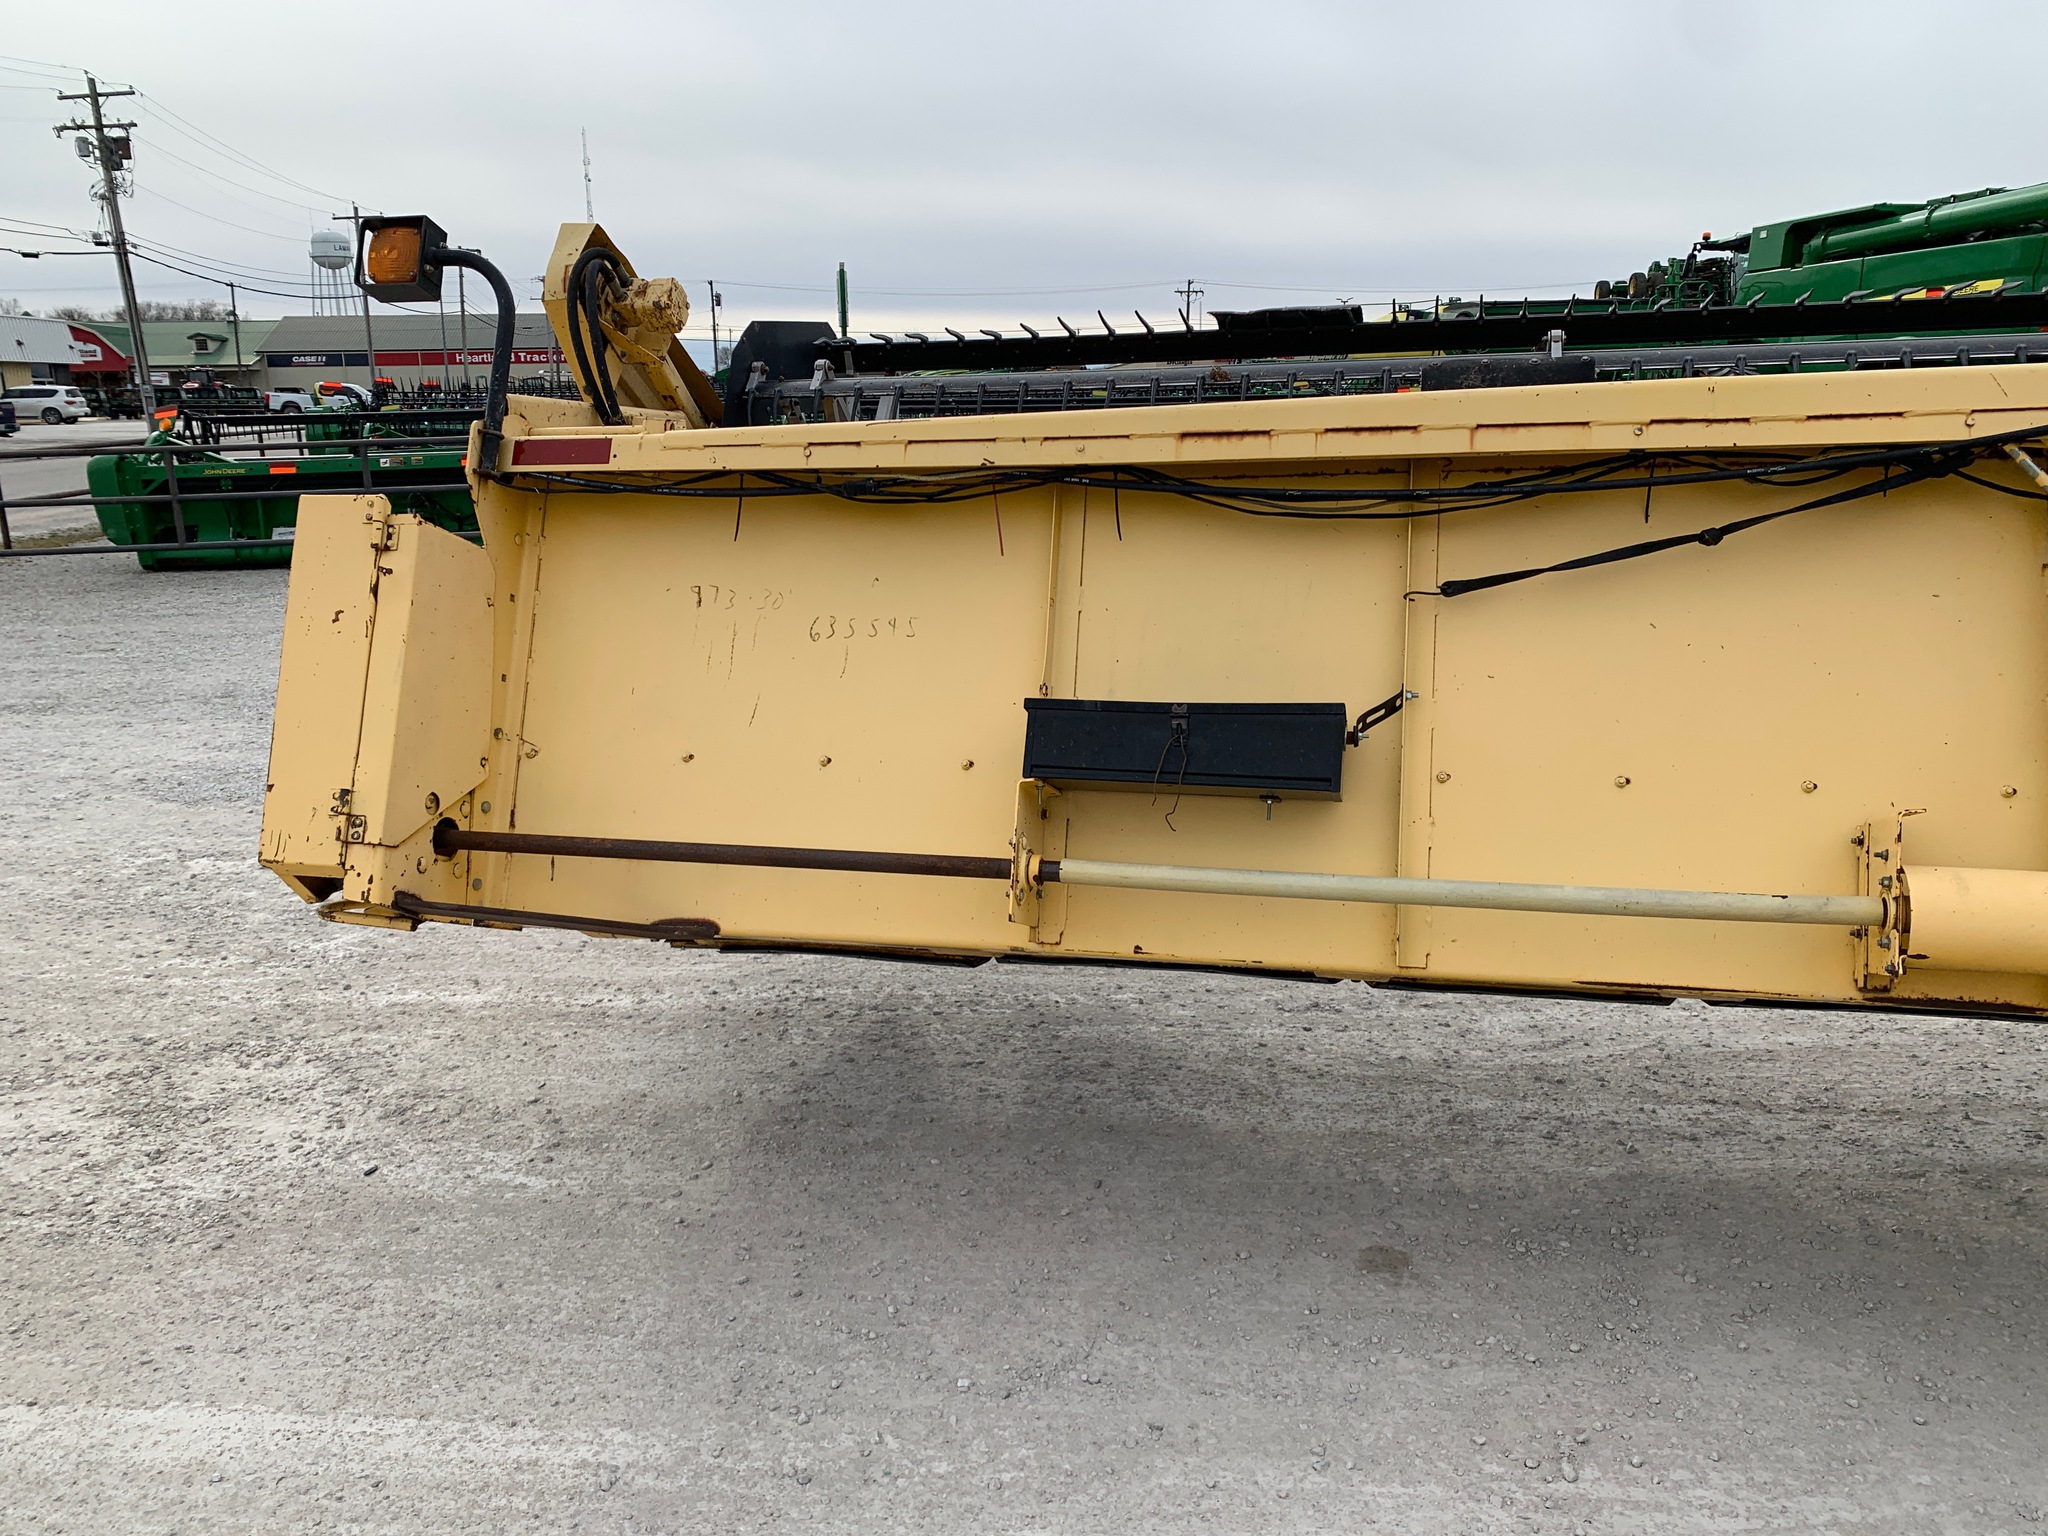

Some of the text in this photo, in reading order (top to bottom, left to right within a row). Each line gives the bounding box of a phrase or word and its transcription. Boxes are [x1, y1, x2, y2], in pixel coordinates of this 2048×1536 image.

[292, 355, 317, 363] CASE
[455, 351, 566, 363] Heartld Tracor
